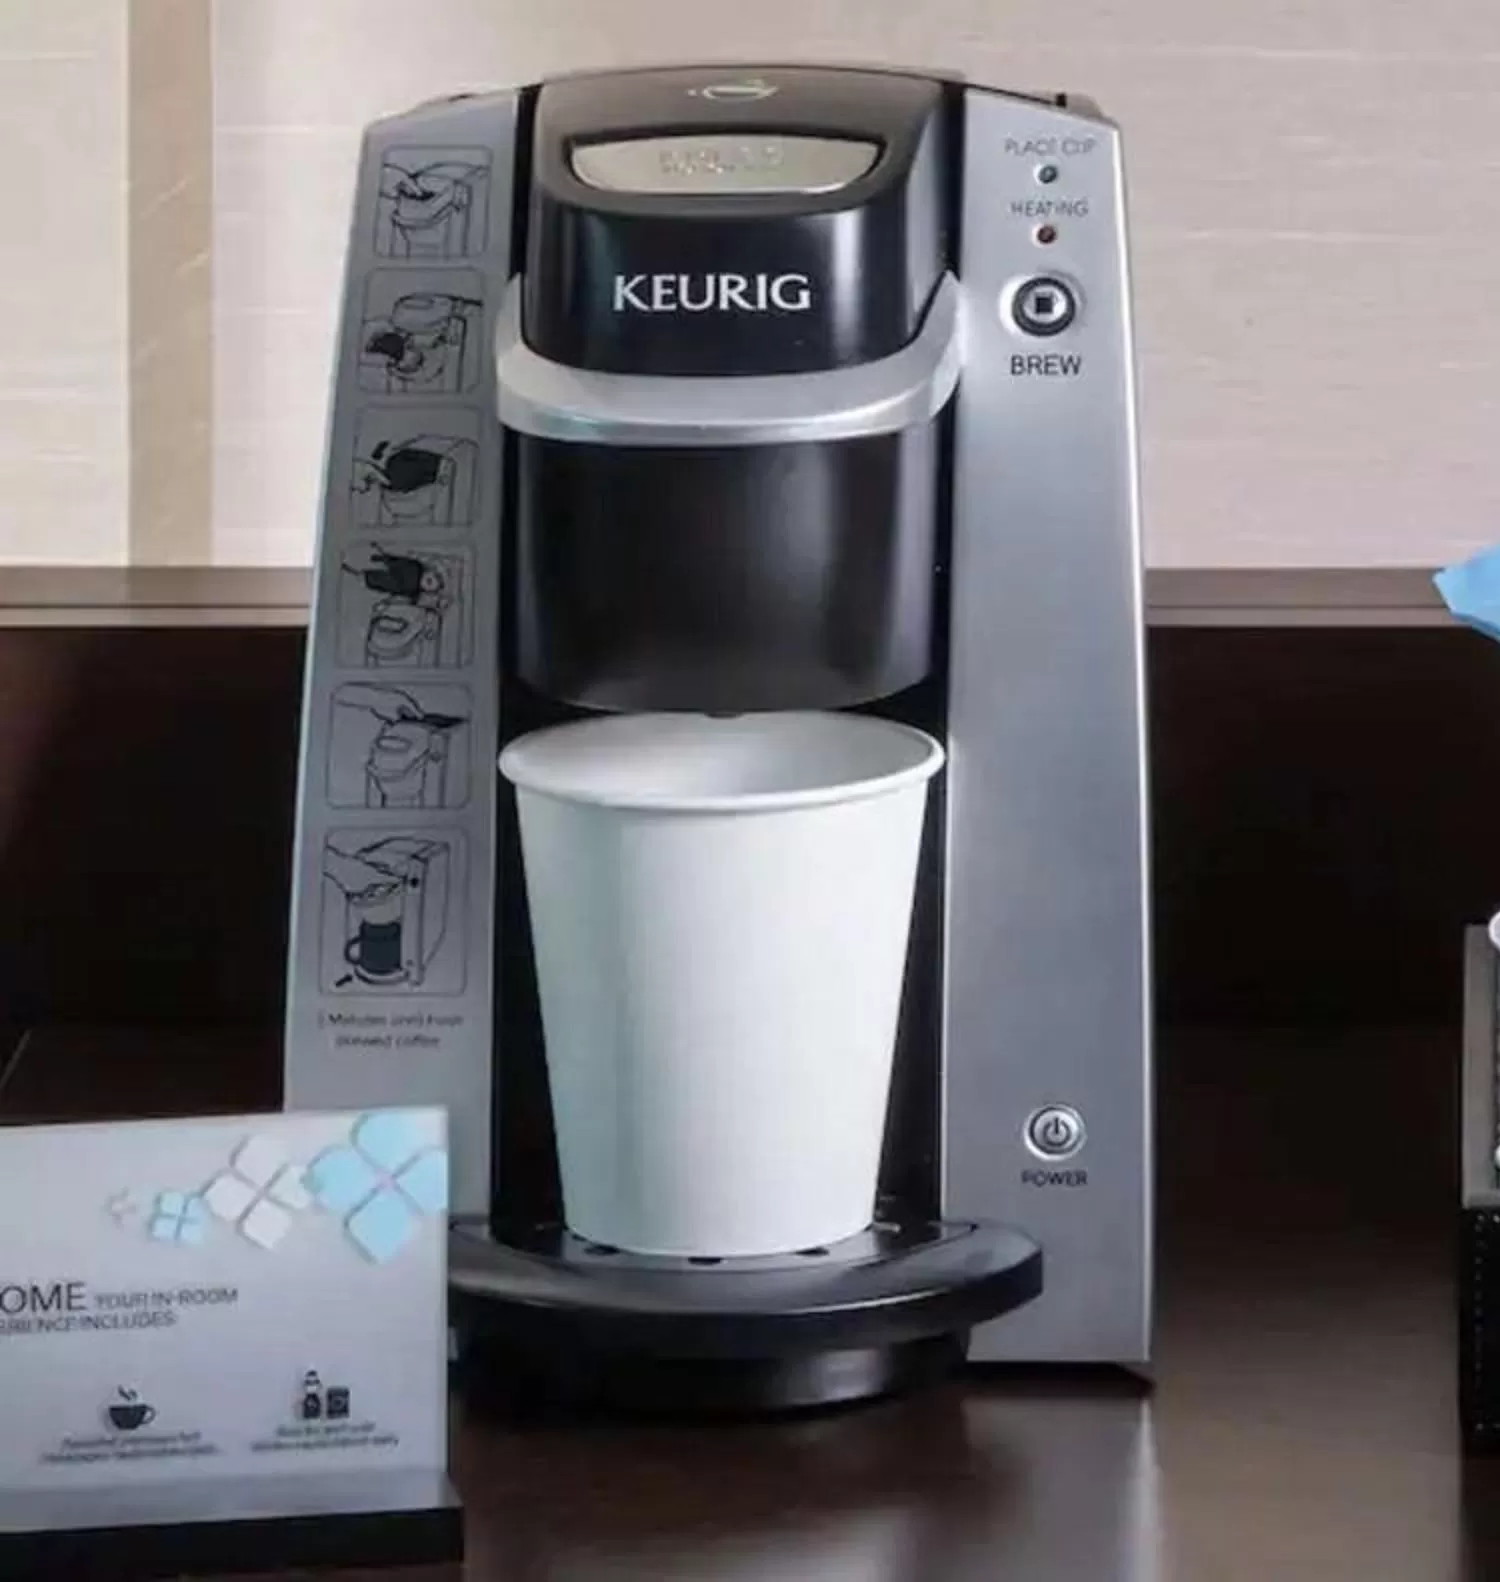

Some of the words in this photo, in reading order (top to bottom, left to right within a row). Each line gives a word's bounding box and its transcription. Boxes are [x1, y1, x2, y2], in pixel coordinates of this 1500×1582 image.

[1010, 200, 1089, 218] HEATING
[613, 272, 811, 312] KEURIG
[1010, 354, 1082, 377] BREW
[1021, 1169, 1088, 1188] POWER
[0, 1280, 88, 1315] OME
